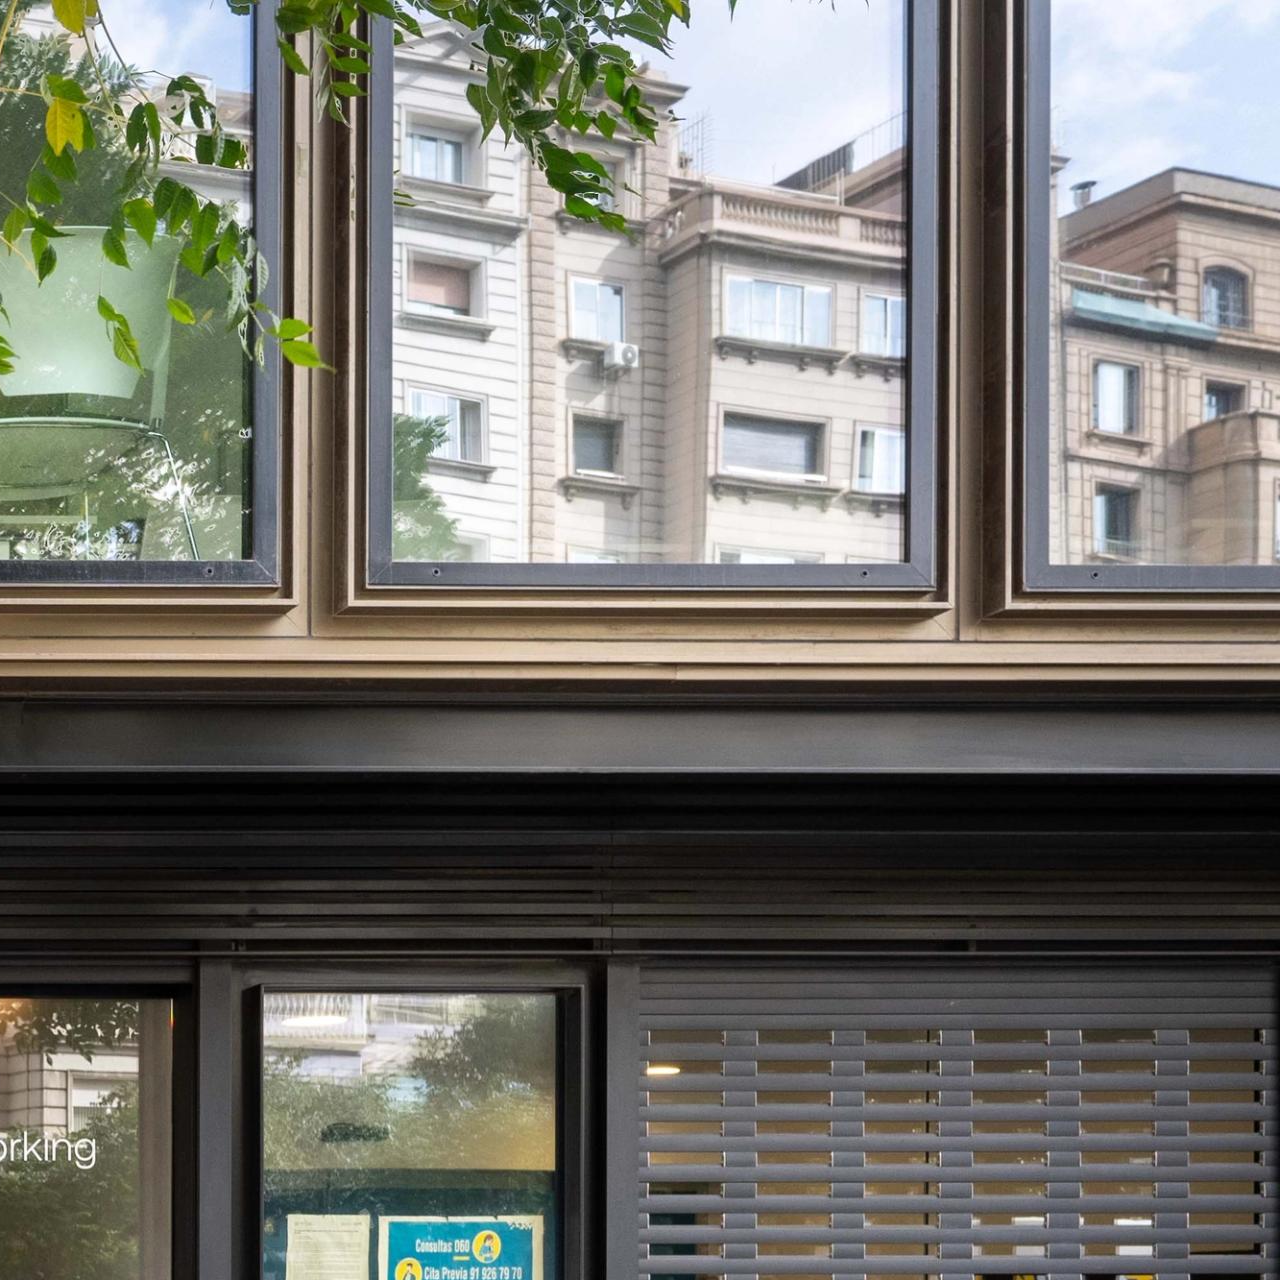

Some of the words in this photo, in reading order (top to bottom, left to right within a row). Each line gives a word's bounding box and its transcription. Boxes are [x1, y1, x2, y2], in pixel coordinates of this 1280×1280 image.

[415, 1238, 453, 1253] Consultas
[454, 1239, 470, 1253] 060
[424, 1266, 439, 1280] Cita
[441, 1266, 468, 1280] Previa
[469, 1266, 480, 1280] 91
[481, 1266, 497, 1280] 926
[499, 1266, 510, 1280] 79
[512, 1266, 523, 1280] 70
